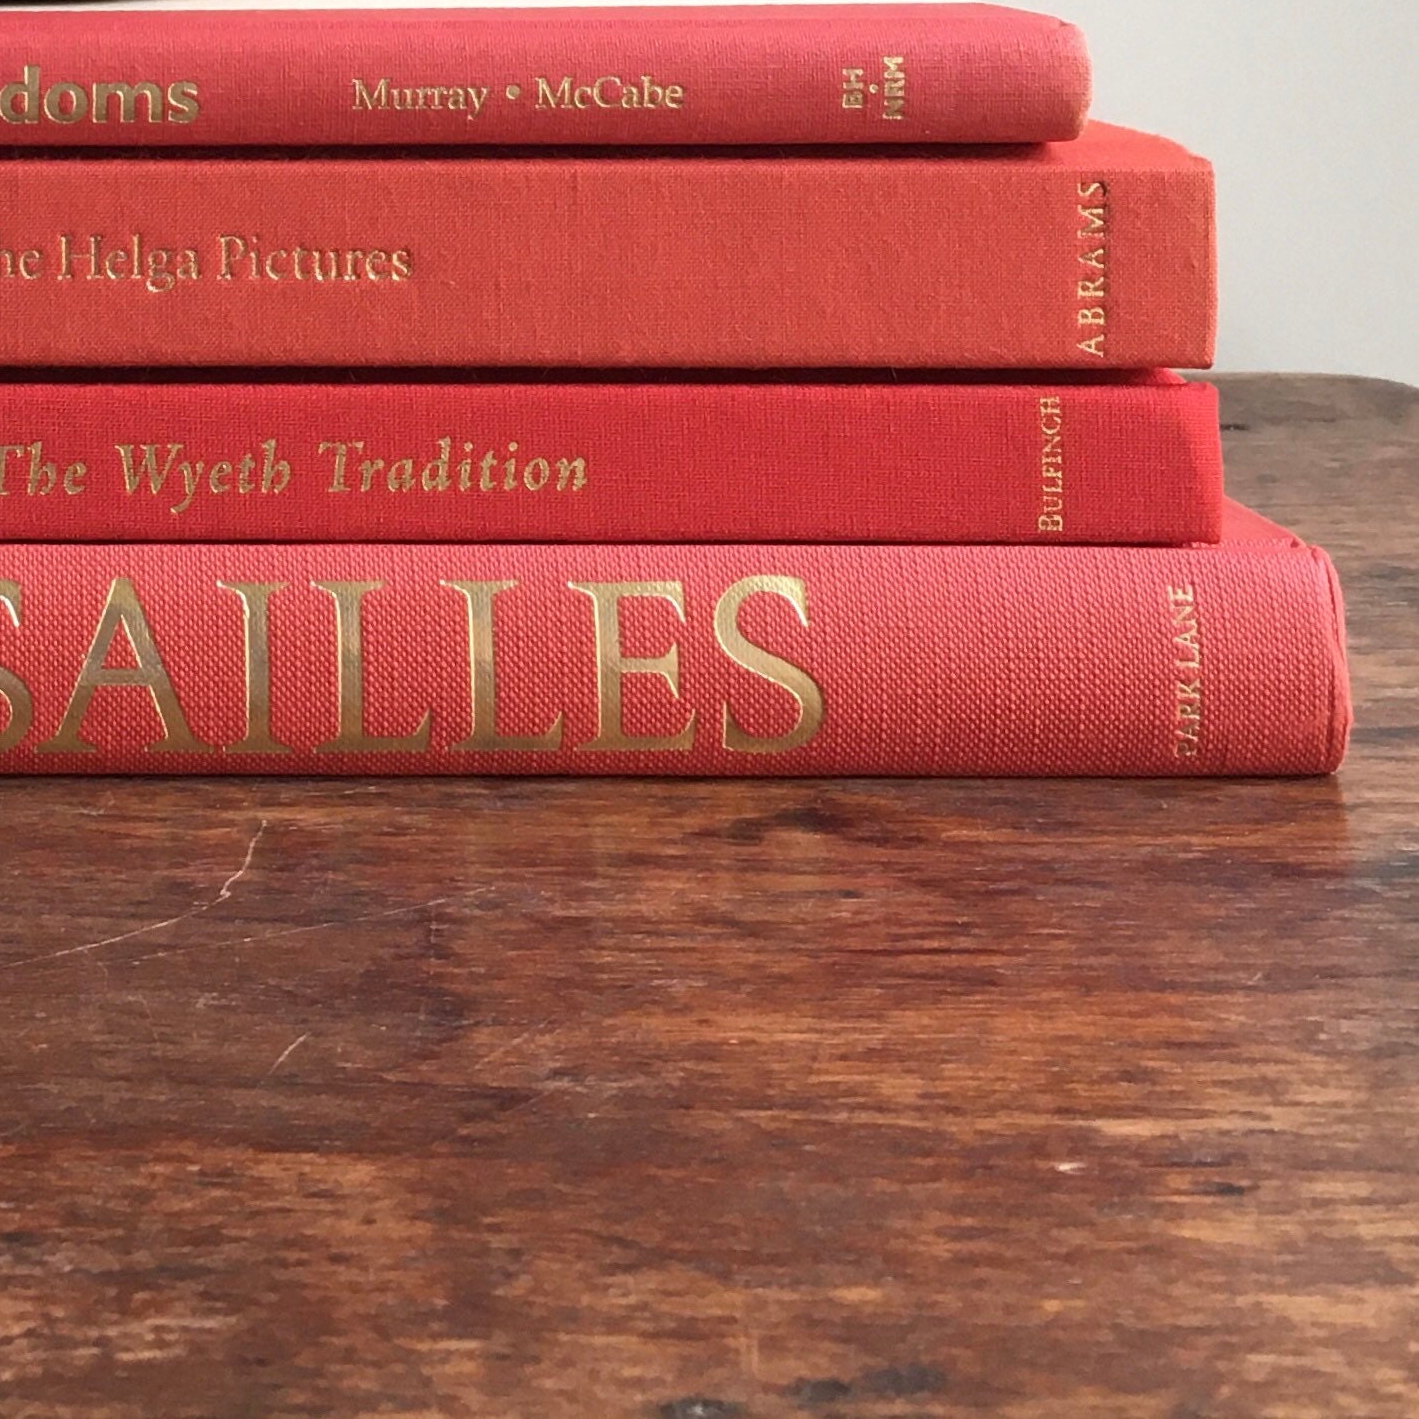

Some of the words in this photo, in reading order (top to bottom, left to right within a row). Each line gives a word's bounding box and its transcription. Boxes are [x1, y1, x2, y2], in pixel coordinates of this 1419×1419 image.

[351, 77, 489, 120] Murray
[534, 76, 685, 111] McCabe
[842, 68, 864, 109] BH
[882, 55, 906, 120] NRM
[57, 233, 202, 293] Helga
[216, 233, 414, 281] Pictures
[1077, 181, 1109, 359] ABRAMS
[115, 439, 292, 514] Wyeth
[318, 437, 588, 494] Tradition
[1168, 583, 1203, 670] LANE
[1173, 678, 1201, 758] PARK
